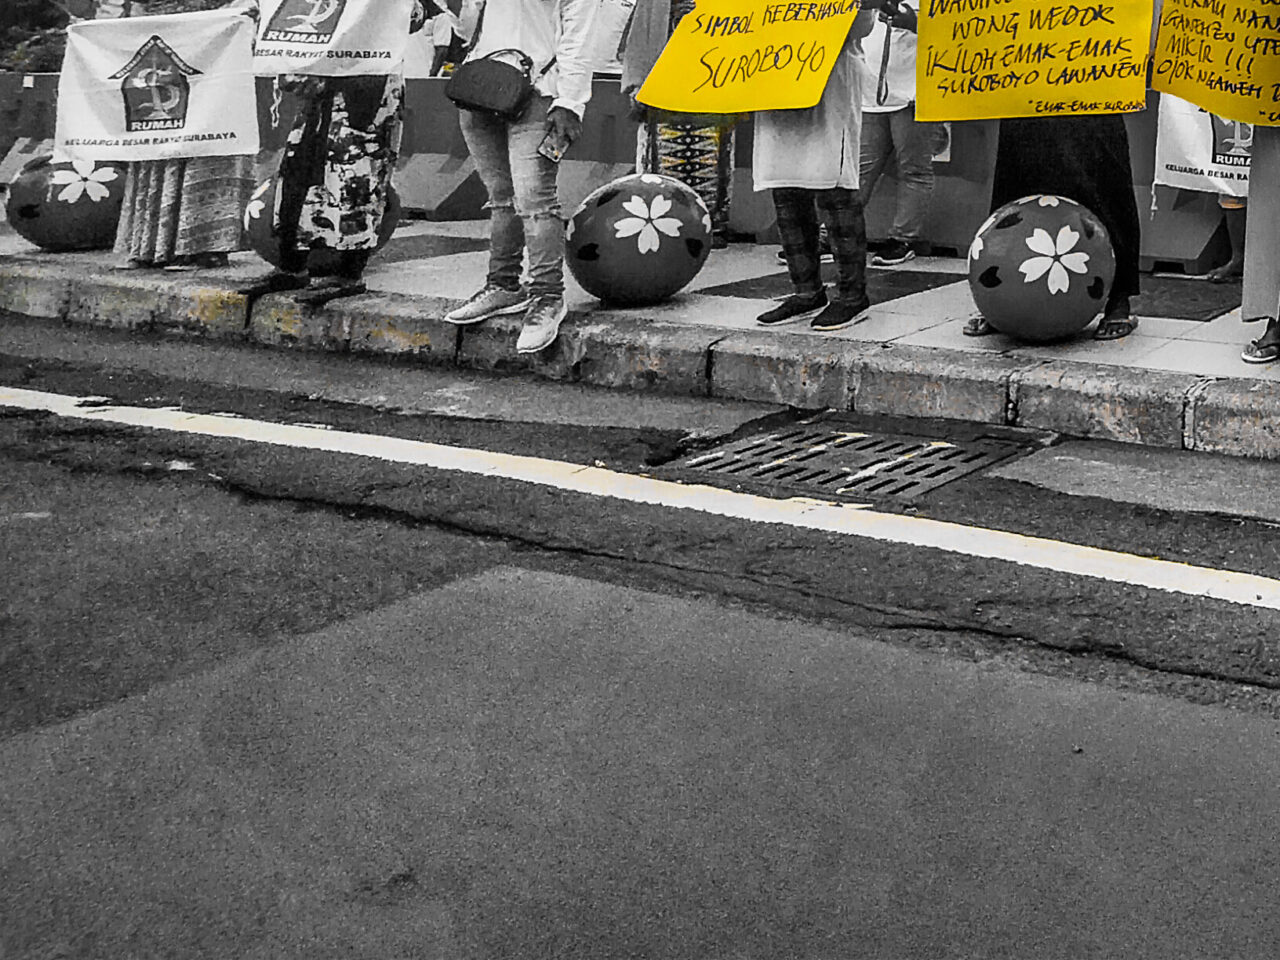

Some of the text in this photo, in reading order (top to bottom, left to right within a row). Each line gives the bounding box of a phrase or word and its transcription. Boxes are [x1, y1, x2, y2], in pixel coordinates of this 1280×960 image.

[691, 11, 754, 37] SIMBOL
[952, 11, 1020, 40] WONG
[266, 31, 331, 44] RUMAH
[1165, 33, 1213, 63] MIKIR
[326, 50, 391, 59] SURABAYA
[693, 40, 825, 93] SUROBOYO
[937, 70, 1039, 98] SUROBOYO
[131, 119, 184, 131] RUMAH
[1165, 163, 1205, 176] KELUARGA
[1207, 169, 1234, 180] BESAR
